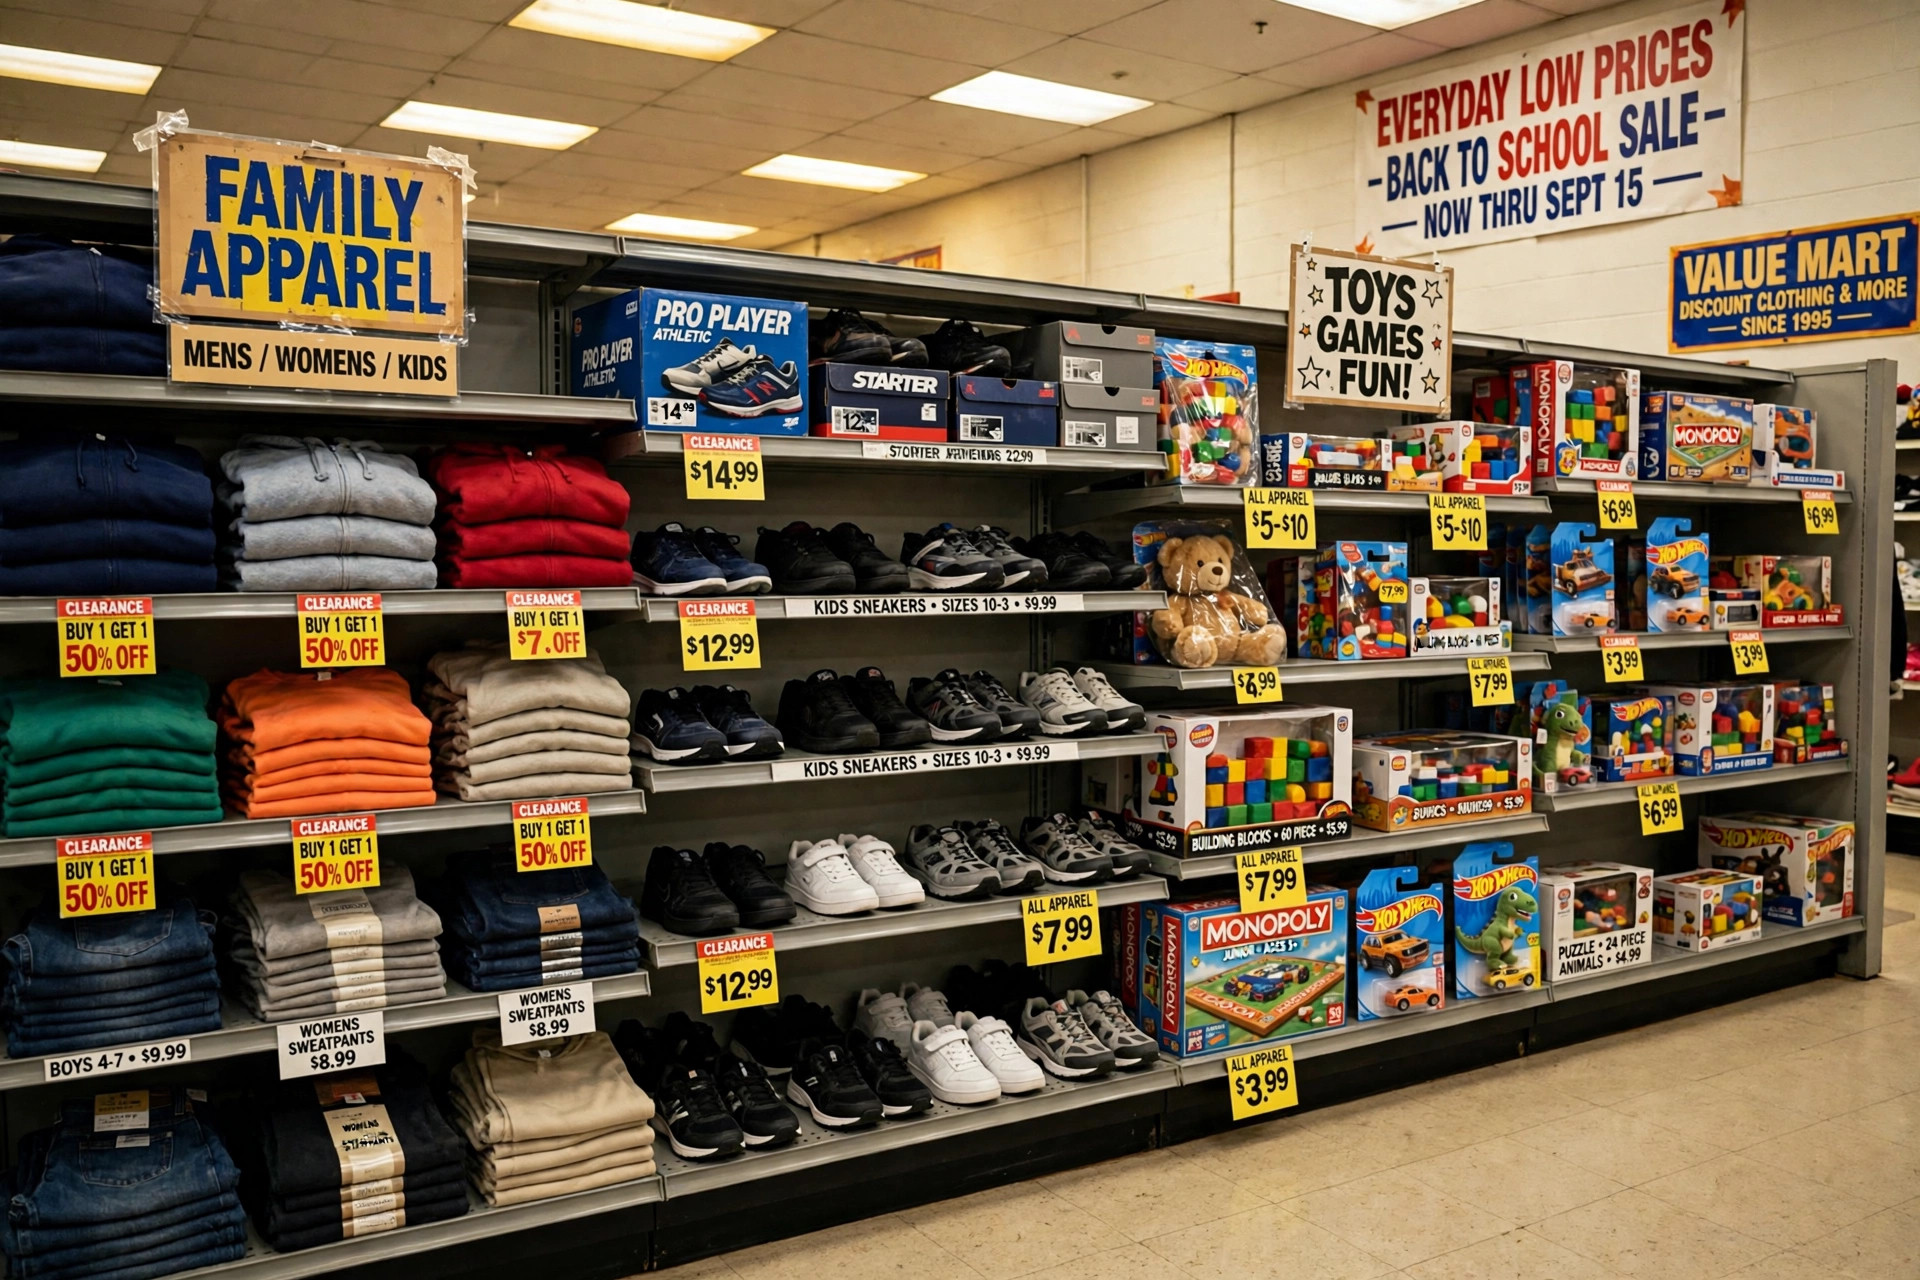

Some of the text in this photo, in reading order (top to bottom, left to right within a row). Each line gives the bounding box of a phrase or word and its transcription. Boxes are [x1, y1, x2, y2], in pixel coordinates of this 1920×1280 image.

[1377, 18, 1712, 147] EVERYDAY LOW PRICES
[1387, 91, 1698, 202] BACK TO SCHOOL SALE
[205, 154, 423, 243] FAMILY
[1425, 167, 1643, 239] NOW THRU SEPT 15
[181, 229, 446, 314] APPAREL
[1683, 227, 1906, 295] VALUE MART
[1325, 267, 1416, 319] TOYS
[1680, 277, 1907, 319] DISCOUNT CLOTHING & MORE
[654, 299, 792, 335] PRO PLAYER
[1741, 309, 1832, 336] SINCE 1995
[653, 329, 712, 343] ATHLETIC
[1316, 316, 1423, 360] GAMES
[183, 339, 252, 370] MENS
[276, 347, 376, 377] WOMENS
[399, 356, 447, 381] KIDS
[582, 337, 633, 372] PRO PLAYER
[852, 370, 938, 394] STARTER
[1339, 359, 1412, 399] FUN!
[1538, 369, 1551, 454] MONOPOLY
[690, 437, 754, 450] CLEARANCE
[1675, 427, 1741, 445] MONOPOLY
[690, 460, 759, 490] $14.99
[1248, 490, 1309, 506] ALL APPAREL
[1433, 496, 1481, 511] ALL APPAREL
[1602, 499, 1633, 523] $6.99
[1252, 510, 1308, 541] $5-$10
[1437, 514, 1482, 542] $5-$10
[1807, 507, 1834, 528] $6.99
[66, 600, 144, 616] CLEARANCE
[304, 597, 374, 611] CLEARANCE
[513, 593, 574, 606] CLEARANCE
[685, 602, 749, 616] CLEARANCE
[814, 595, 1057, 615] KIDS SNEAKERS SIZES 10-3 $9.99
[66, 621, 147, 640] BUY 1 GET 1
[305, 616, 377, 633] BUY 1 GET 1
[514, 611, 579, 627] BUY 1 GET 1
[305, 637, 378, 664] 50% OFF
[553, 632, 580, 653] OFF
[686, 633, 755, 663] $12.99
[65, 643, 148, 672] 50% OFF
[1607, 651, 1638, 675] $3.99
[1735, 645, 1763, 668] $3.99
[1474, 673, 1507, 698] $7.99
[804, 745, 1050, 778] KIDS SNEAKERS SIZES 10-3 $9.99
[519, 801, 582, 817] CLEARANCE
[1644, 798, 1677, 827] $6.99
[300, 818, 368, 835] CLEARANCE
[520, 819, 585, 839] BUY 1 GET 1
[1192, 821, 1348, 851] BUILDING BLOCKS 60 PIECE $5.99
[65, 836, 143, 855] CLEARANCE
[300, 837, 371, 858] BUY 1 GET 1
[520, 840, 586, 868] 50% OFF
[1241, 850, 1298, 868] ALL APPAREL
[66, 857, 147, 880] BUY 1 GET 1
[300, 860, 373, 888] 50% OFF
[65, 881, 148, 912] 50% OFF
[1246, 867, 1297, 903] $7.99
[1471, 866, 1534, 900] HOT WHEELS
[1027, 894, 1093, 914] ALL APPAREL
[1373, 896, 1438, 932] HOT WHEELS
[1032, 915, 1093, 955] $7.99
[1206, 901, 1329, 946] MONOPOLY
[703, 936, 768, 956] CLEARANCE
[1559, 931, 1646, 960] PUZZLE 24 PIECE
[1559, 947, 1641, 976] ANIMALS $4.99
[519, 988, 571, 1007] WOMENS
[705, 968, 773, 1002] $12.99
[508, 1000, 586, 1024] SWEATPANTS
[299, 1017, 360, 1039] WOMENS
[529, 1019, 569, 1037] $8.99
[288, 1030, 375, 1056] SWEATPANTS
[49, 1043, 187, 1078] BOYS 4-7 $9.99
[310, 1050, 357, 1071] $8.99
[1231, 1049, 1288, 1072] ALL APPAREL
[1236, 1068, 1288, 1107] $3.99
